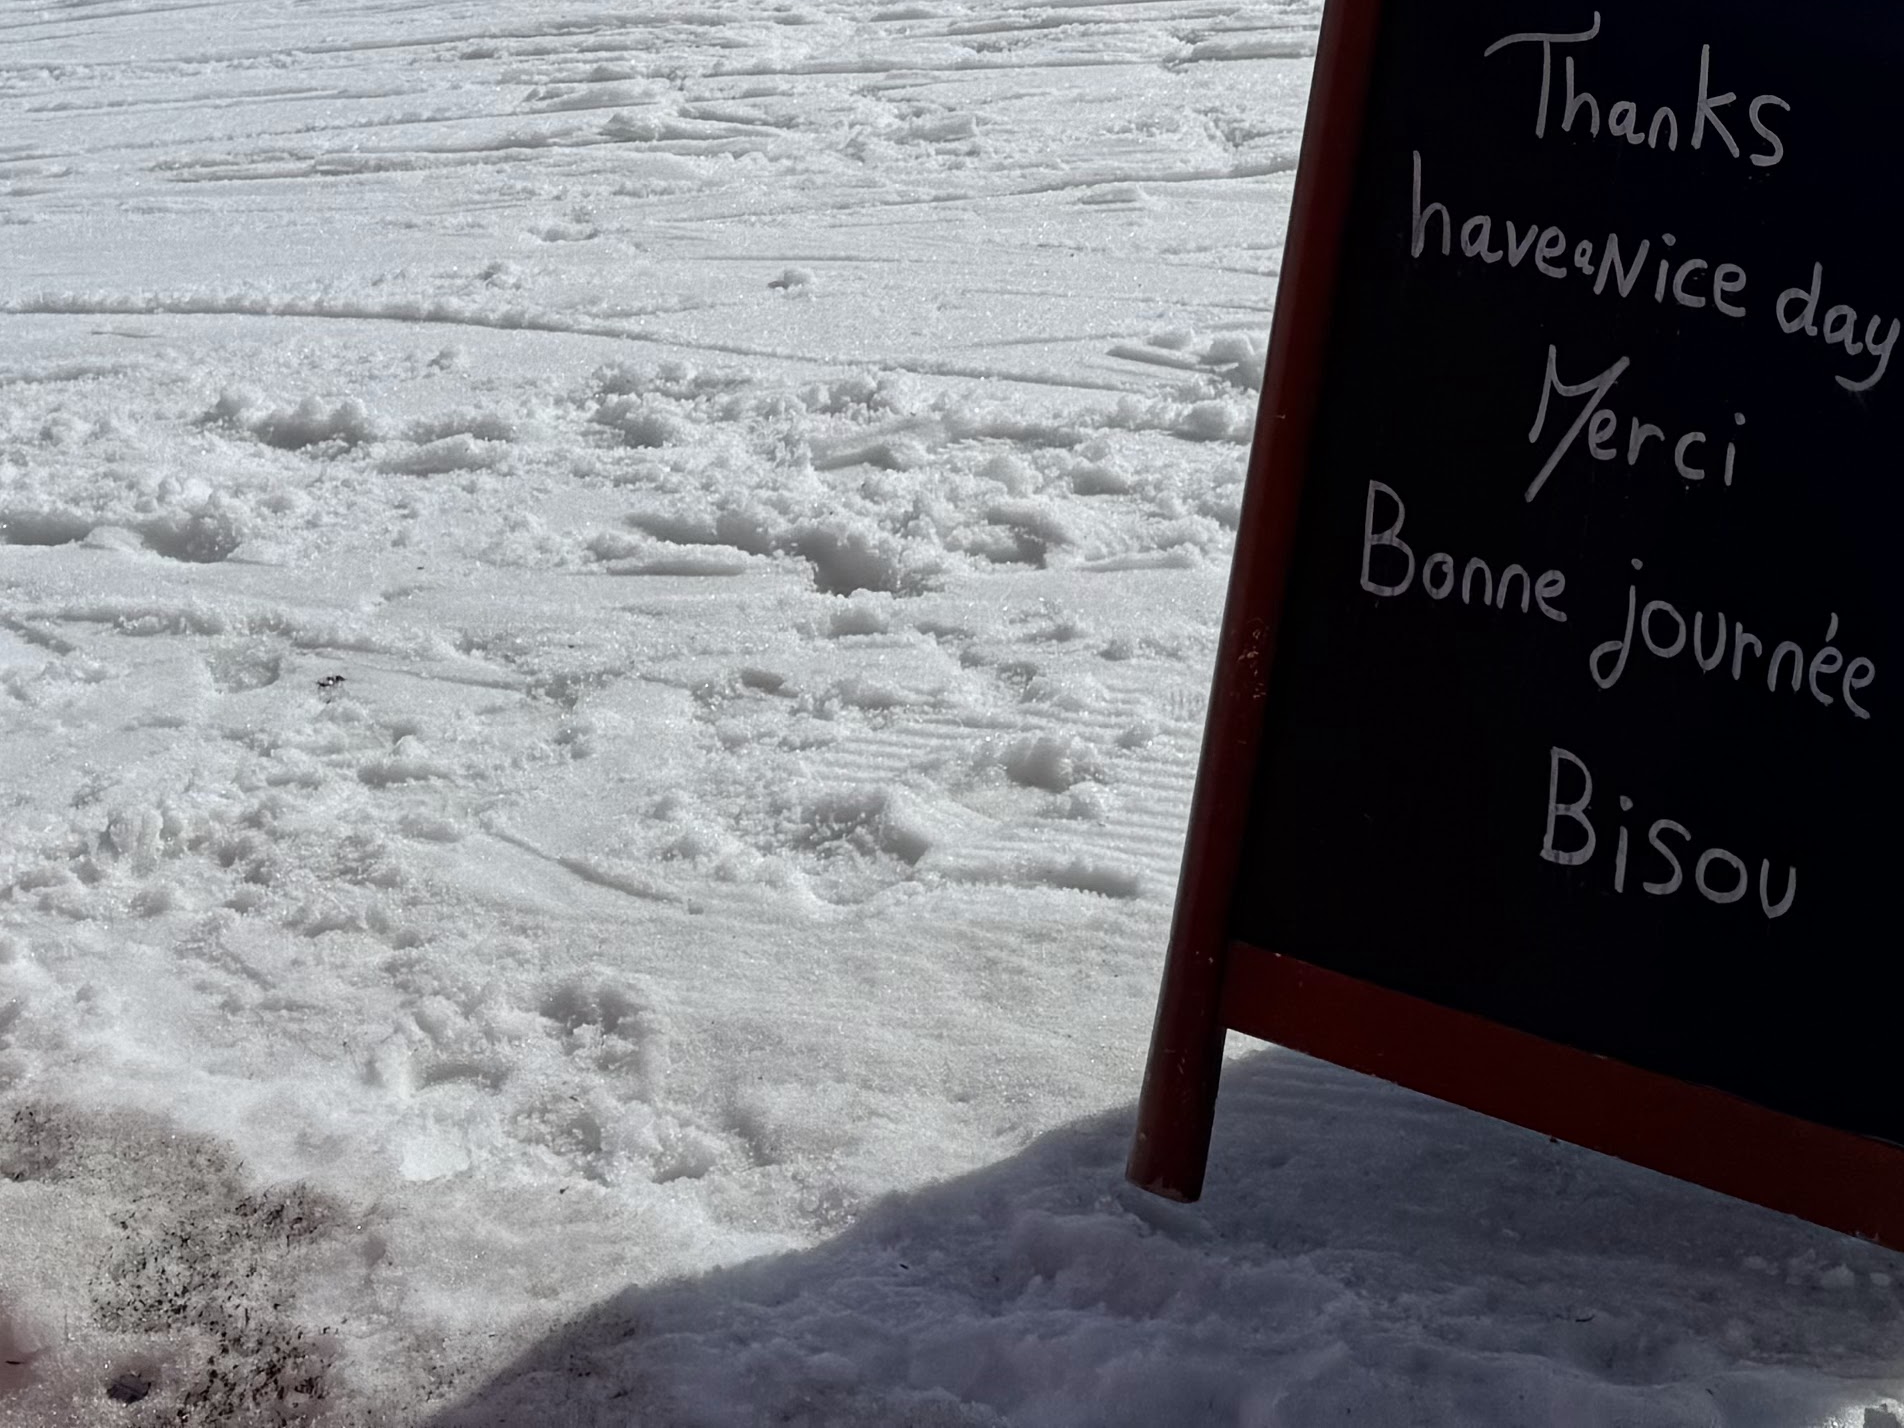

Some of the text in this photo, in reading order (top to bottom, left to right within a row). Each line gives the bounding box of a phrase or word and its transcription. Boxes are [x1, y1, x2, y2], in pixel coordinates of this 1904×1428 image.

[1483, 10, 1792, 168] Thanks
[1410, 149, 1569, 280] have
[1774, 260, 1902, 393] day
[1524, 343, 1749, 504] Merci
[1358, 478, 1877, 721] Bonne journée
[1538, 744, 1798, 920] Bisou
